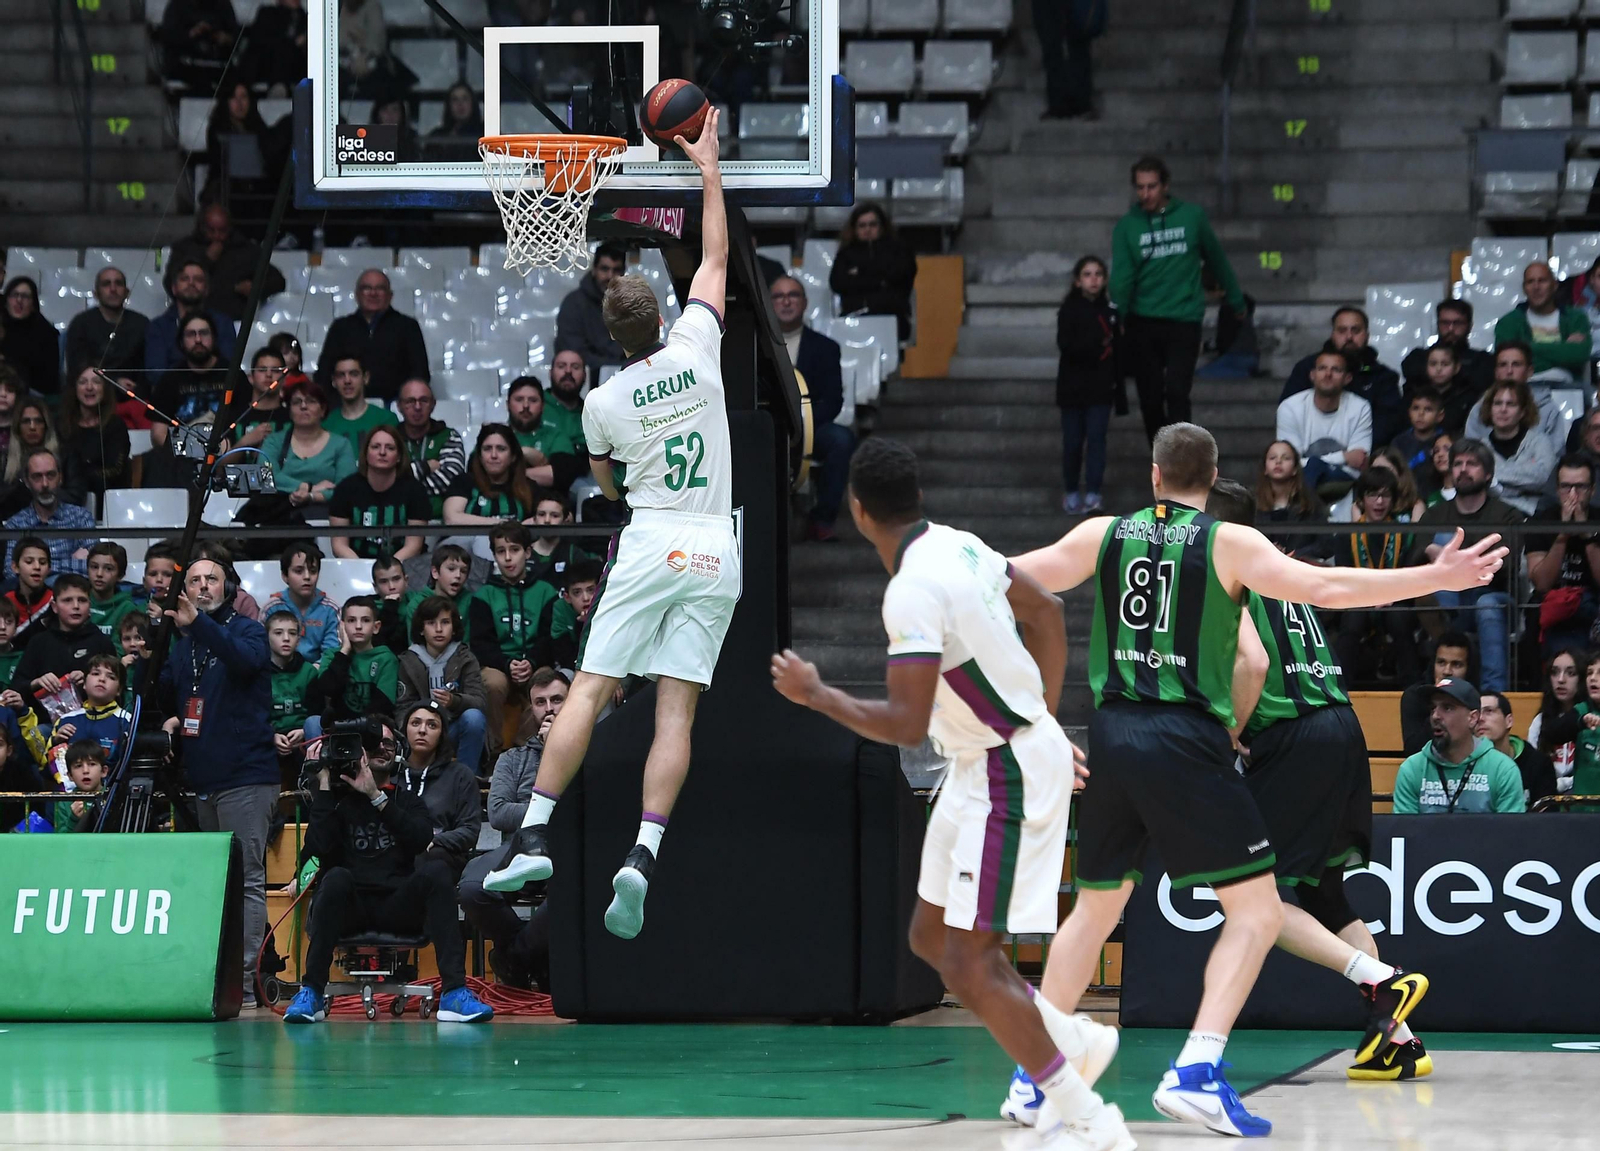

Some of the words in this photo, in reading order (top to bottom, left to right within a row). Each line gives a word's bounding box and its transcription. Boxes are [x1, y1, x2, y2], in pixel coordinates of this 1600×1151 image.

[106, 117, 131, 135] 17
[1285, 119, 1307, 137] 17
[338, 135, 364, 150] liga
[338, 148, 395, 162] endesa
[632, 368, 697, 408] GERUN
[663, 431, 708, 492] 52
[690, 561, 705, 570] DEL
[706, 563, 720, 573] SOL
[691, 553, 721, 565] COSTA
[1119, 557, 1176, 633] 81
[13, 888, 172, 935] FUTUR
